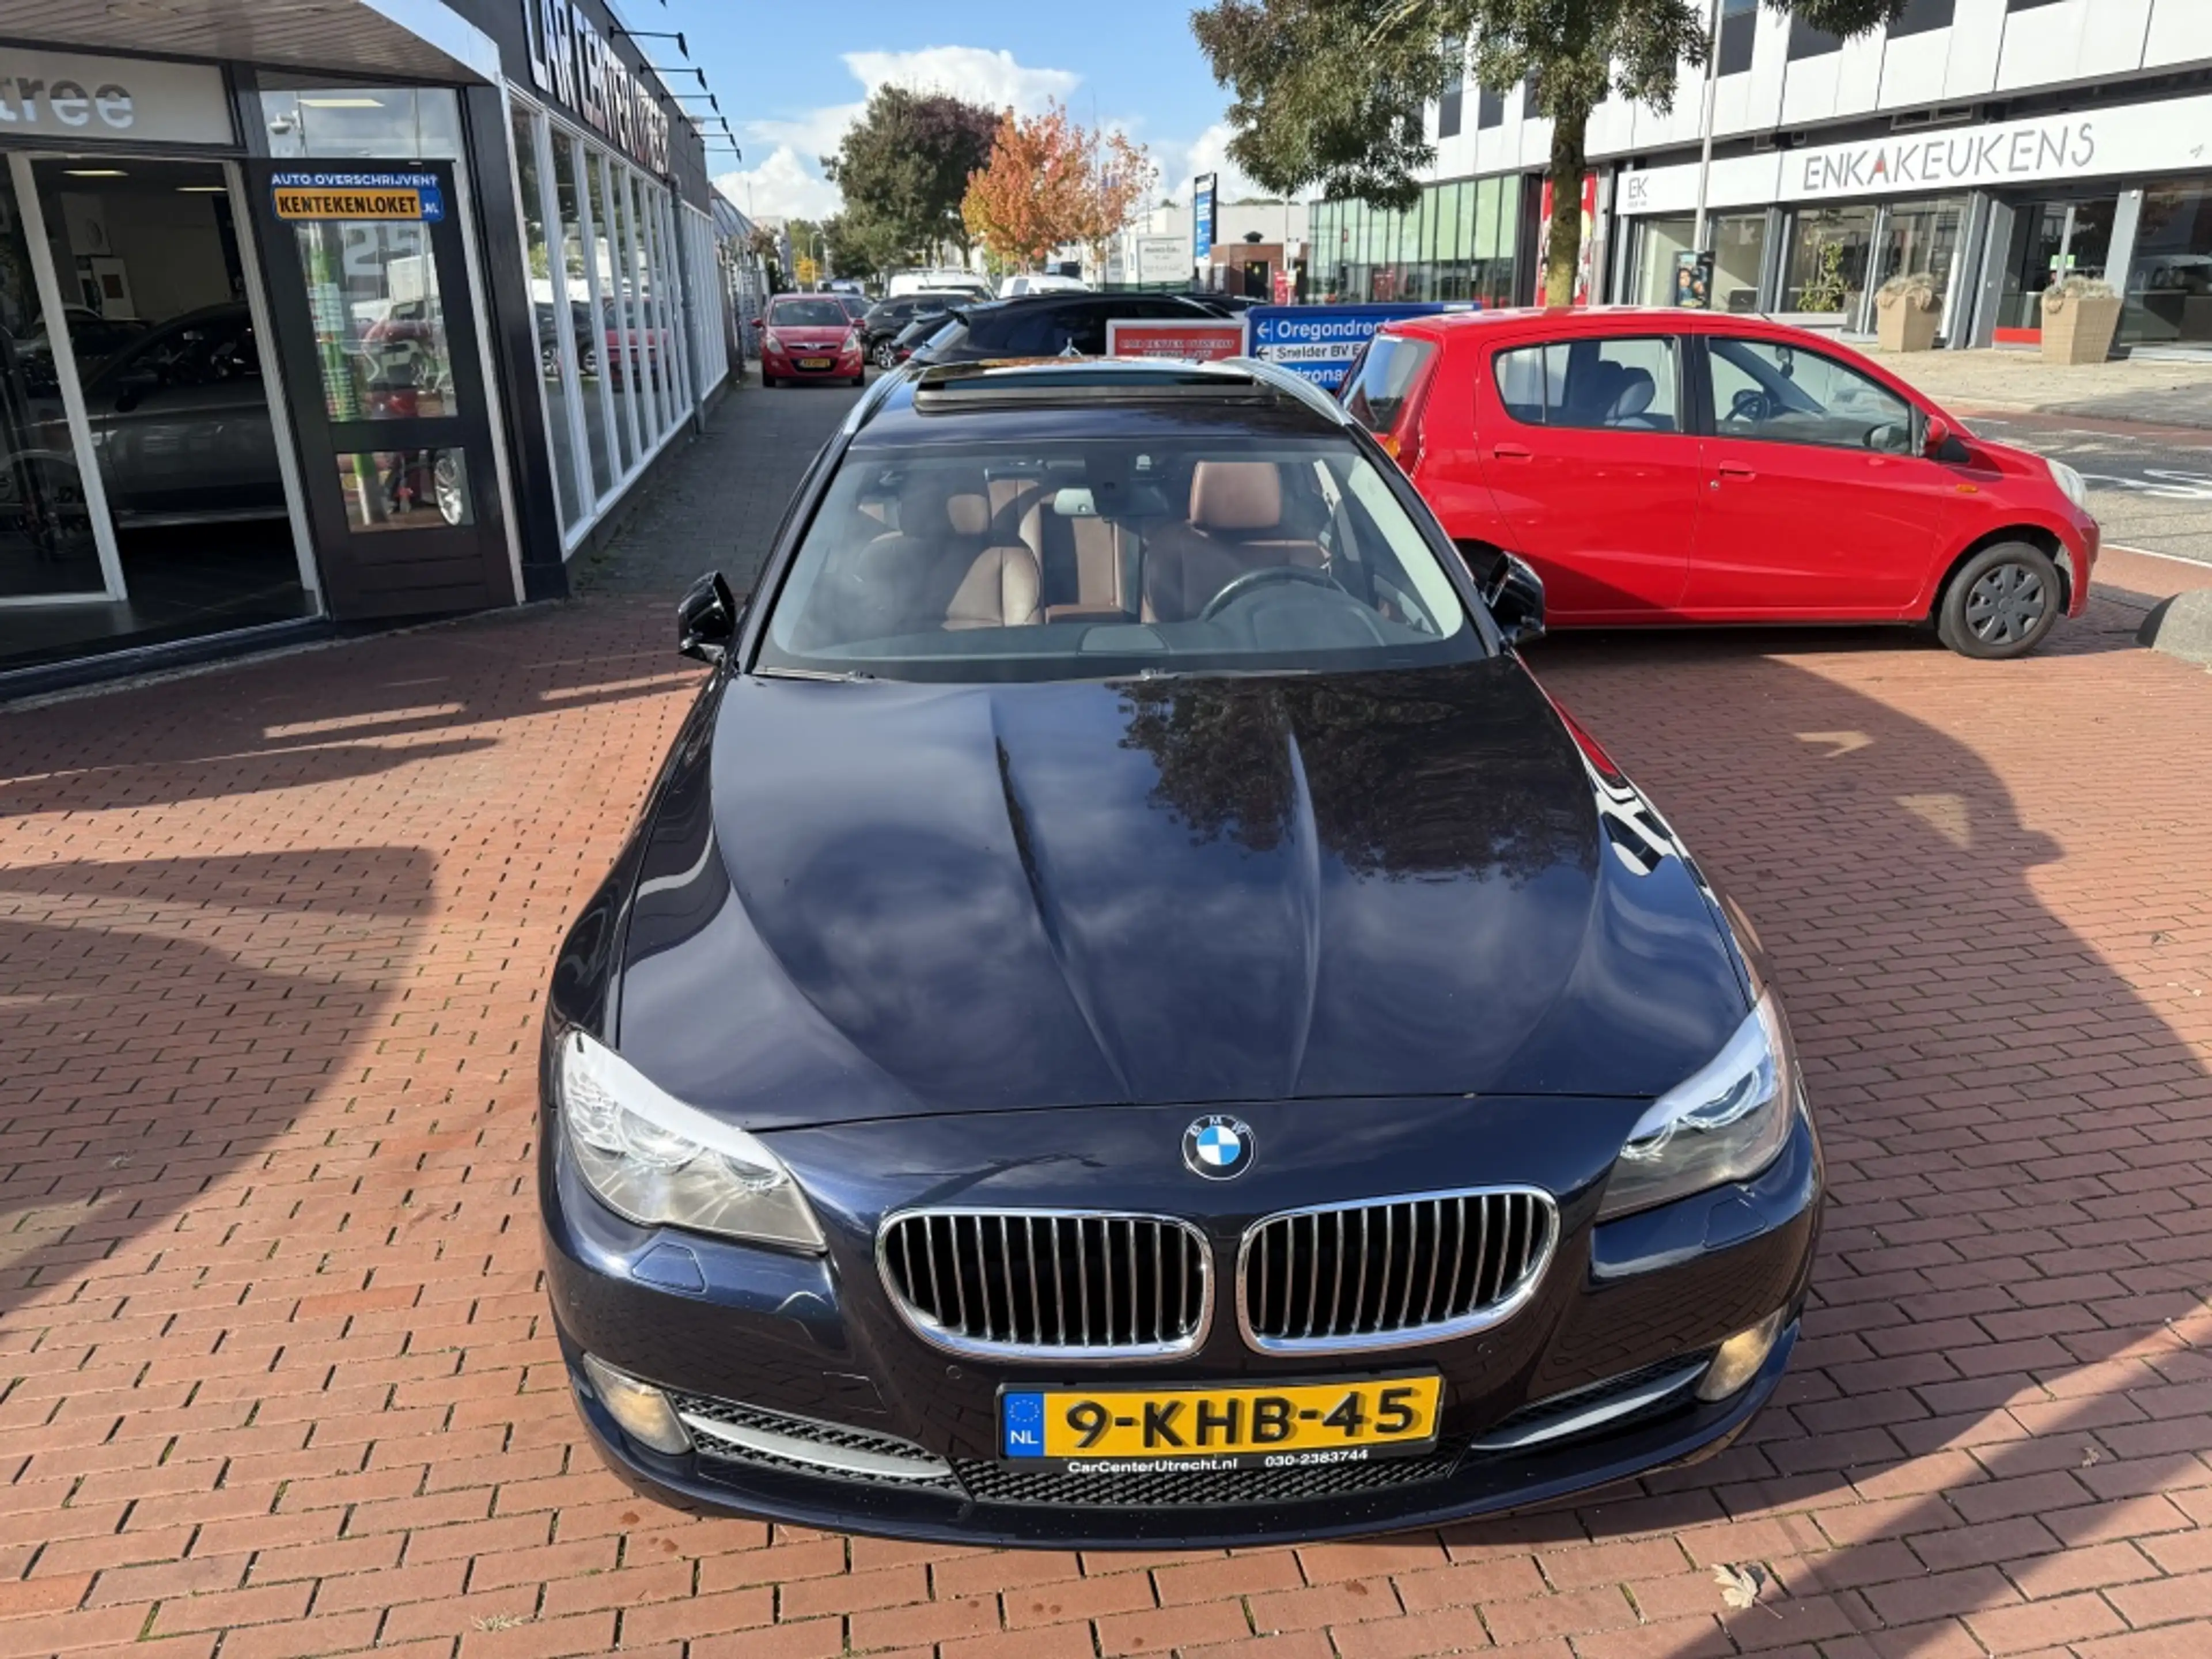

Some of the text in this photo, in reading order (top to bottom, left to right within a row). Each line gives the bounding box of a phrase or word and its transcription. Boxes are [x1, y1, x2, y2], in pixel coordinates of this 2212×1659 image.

[1803, 122, 2094, 191] ENKAKEUKENS
[272, 174, 310, 185] AUTO
[1628, 175, 1649, 199] EK
[278, 196, 416, 214] KENTEKENLOKET
[1277, 346, 1327, 359] Snelder
[1331, 344, 1349, 358] BV
[1188, 1116, 1251, 1138] BMW
[1066, 1387, 1416, 1449] 9-KHB-45
[1010, 1430, 1040, 1445] NL
[1067, 1449, 1368, 1474] CarCenterUtrecht.nl 030-2383744
